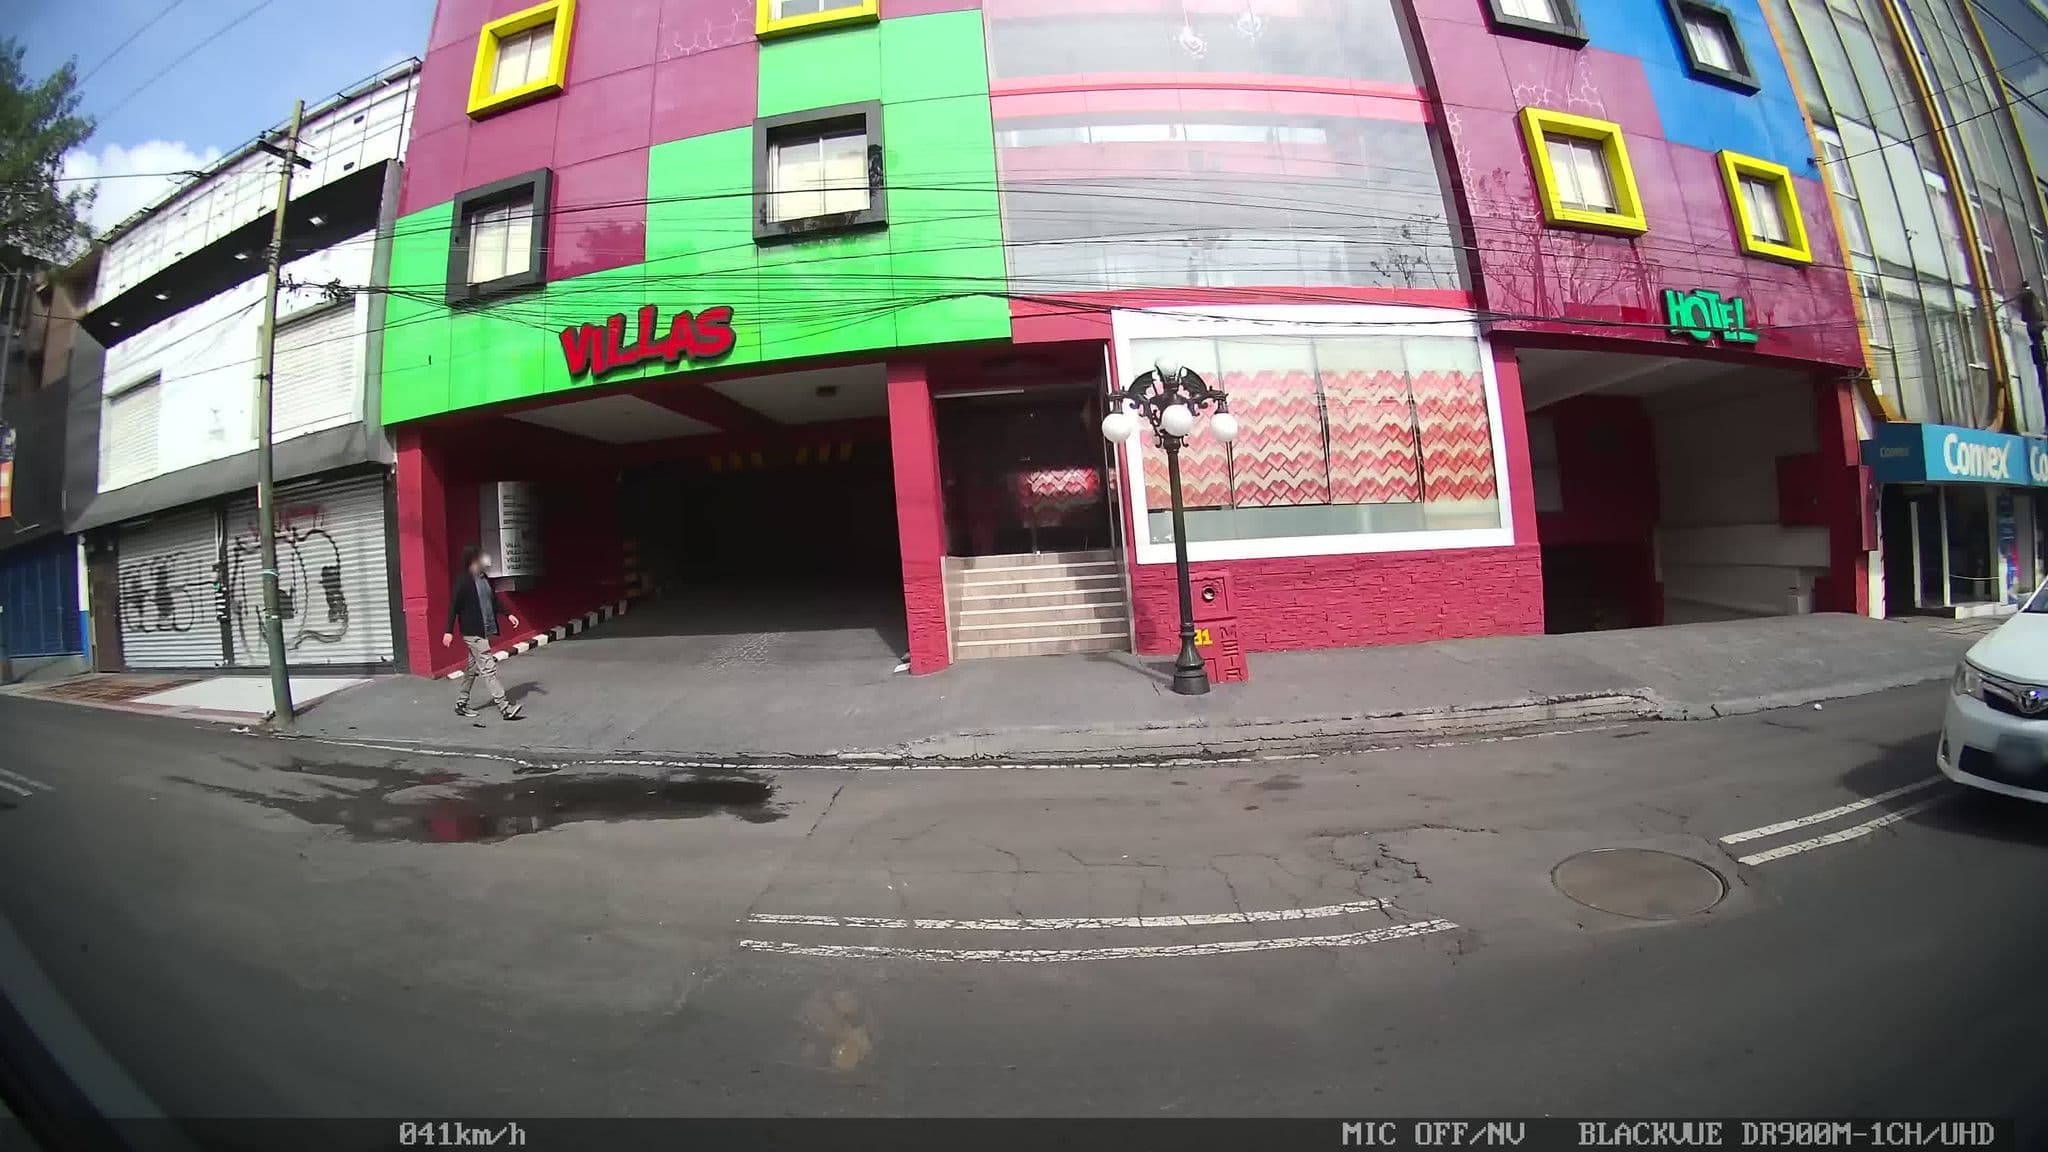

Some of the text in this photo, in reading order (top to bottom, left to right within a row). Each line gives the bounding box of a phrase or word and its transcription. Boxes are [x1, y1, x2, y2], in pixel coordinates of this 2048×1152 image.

[559, 304, 737, 379] VILLAS
[1664, 288, 1759, 343] HOTEL
[1943, 432, 2011, 480] Comex
